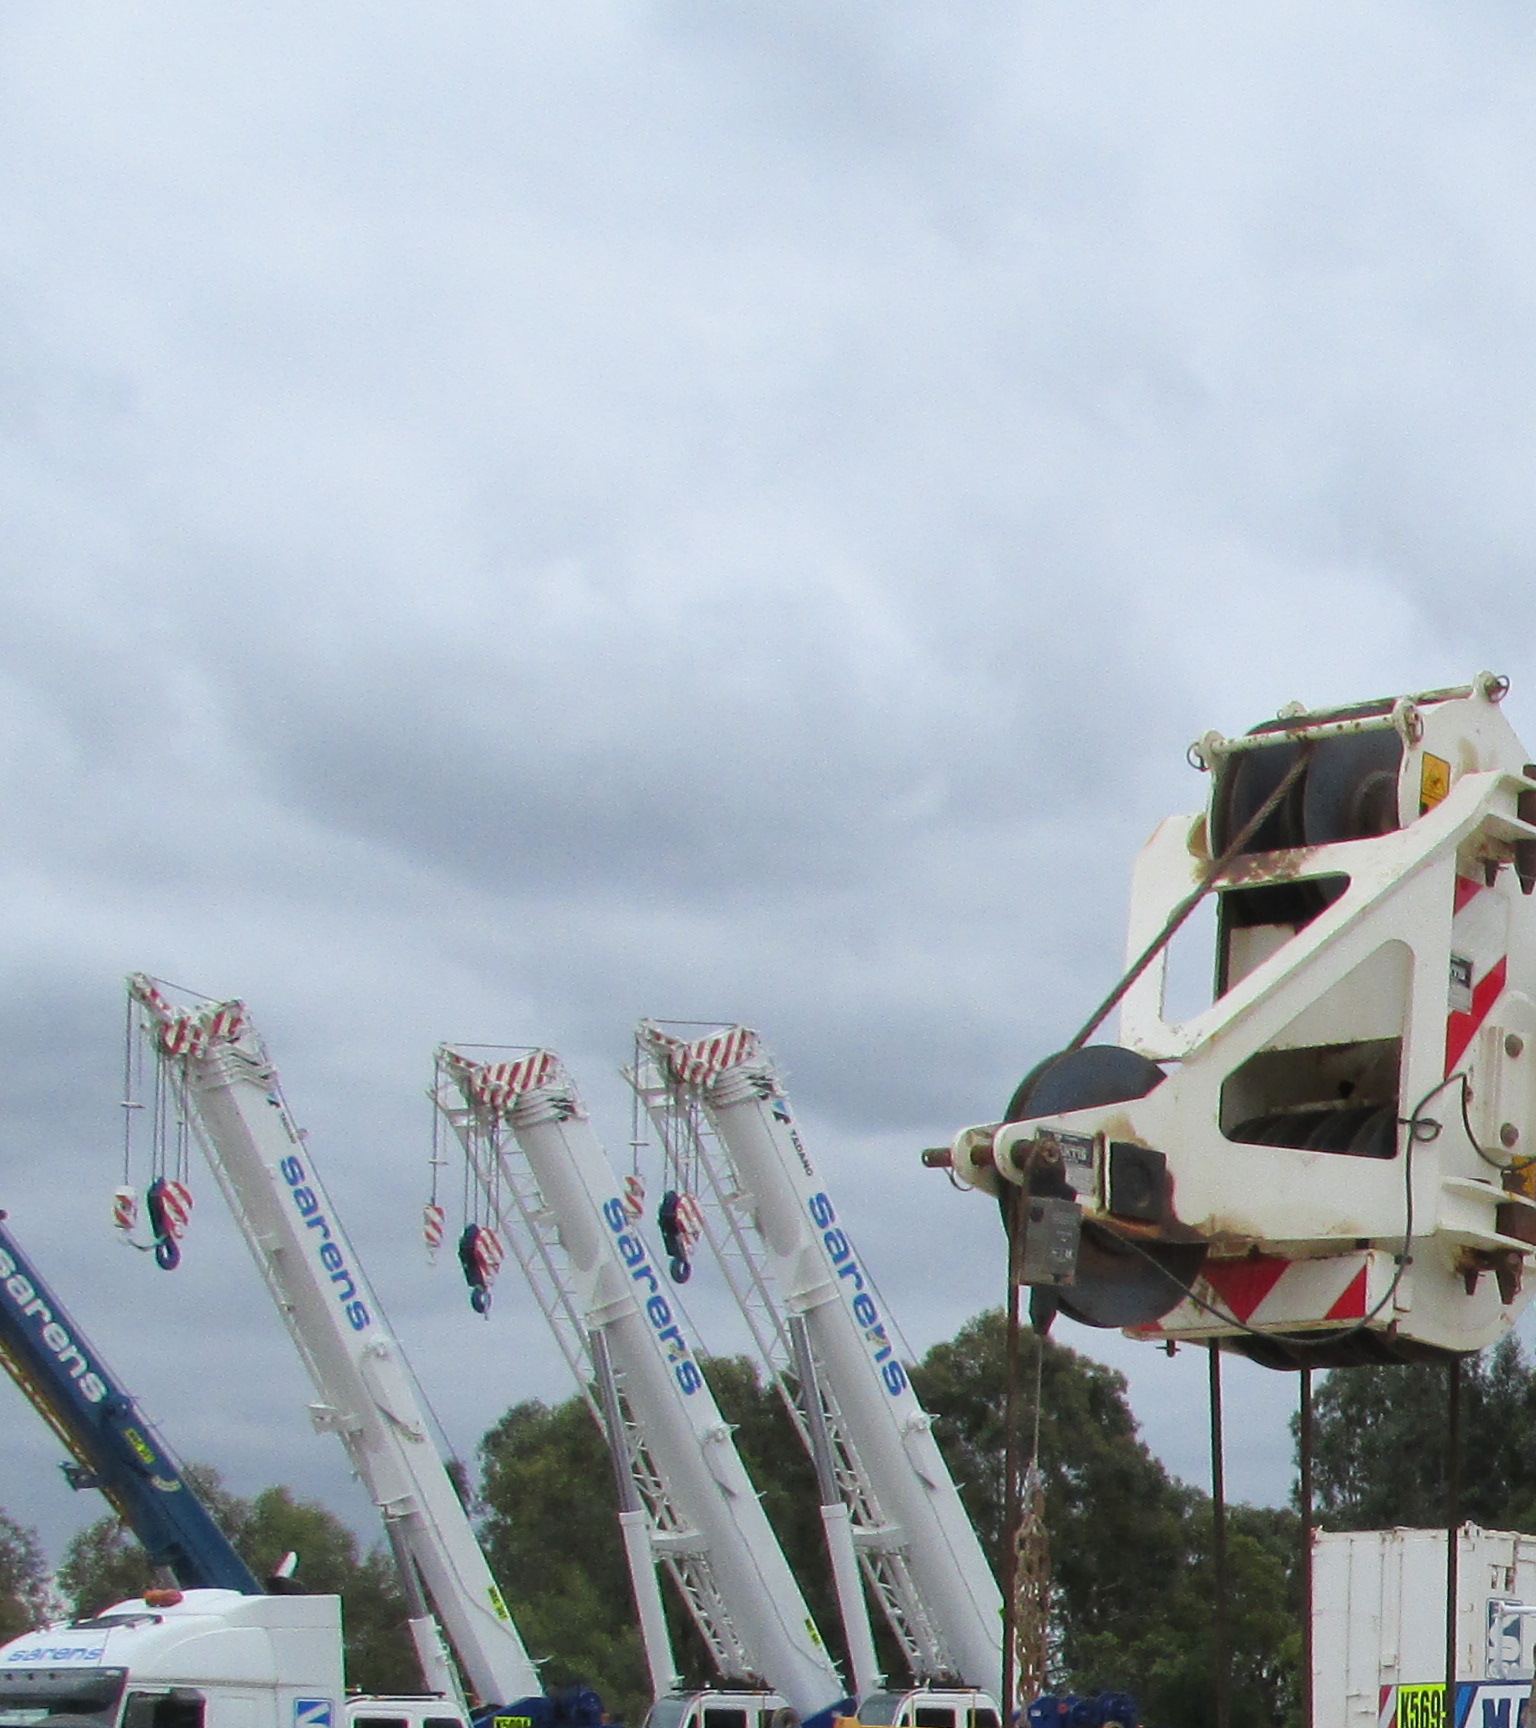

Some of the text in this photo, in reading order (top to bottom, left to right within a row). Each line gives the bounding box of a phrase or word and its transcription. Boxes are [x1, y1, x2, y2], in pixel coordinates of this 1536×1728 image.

[280, 1155, 370, 1332] sarens
[602, 1197, 701, 1396] sarens
[808, 1192, 908, 1397] sarens
[7, 1647, 106, 1662] sarens
